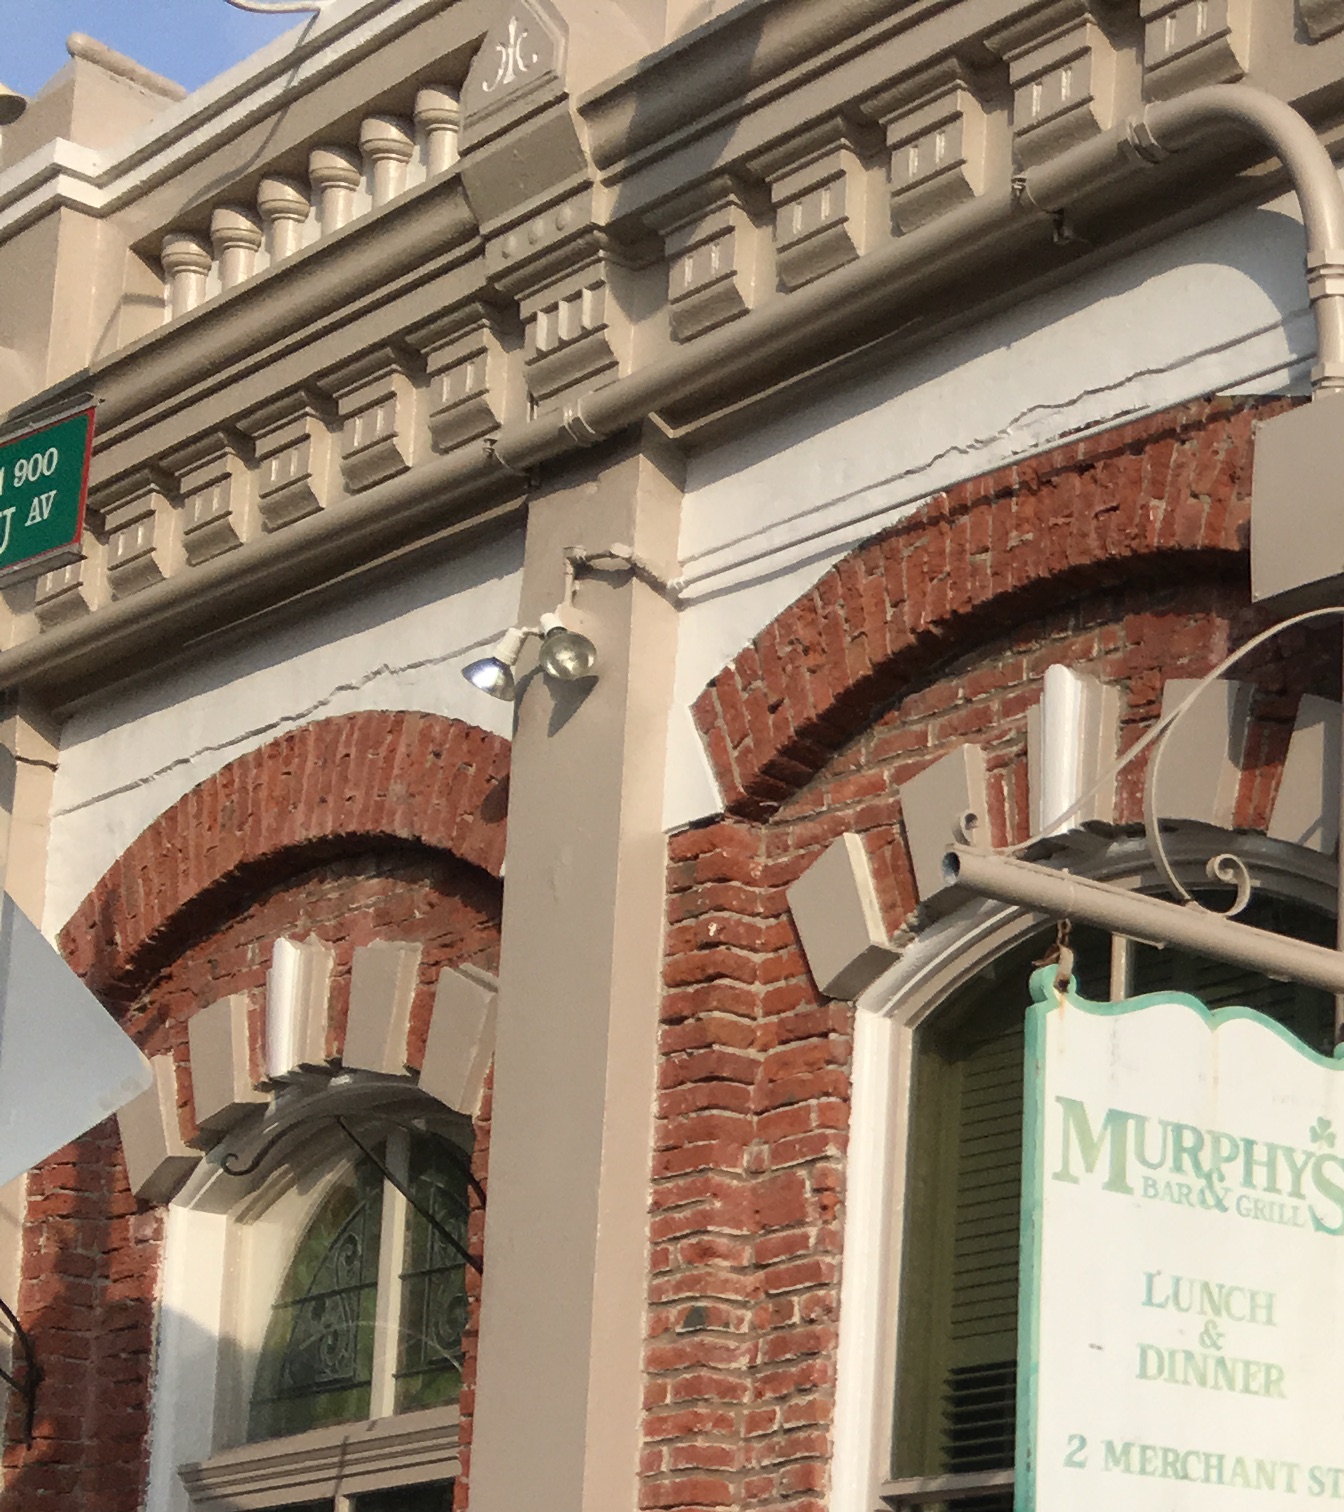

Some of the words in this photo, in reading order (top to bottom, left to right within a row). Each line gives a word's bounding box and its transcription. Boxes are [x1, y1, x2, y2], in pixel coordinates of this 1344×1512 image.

[13, 447, 58, 488] 900
[24, 490, 57, 527] AV
[1140, 1271, 1278, 1327] LUNCH
[1198, 1319, 1226, 1352] &
[1135, 1342, 1288, 1399] DINNER
[1063, 1433, 1089, 1469] 2
[1100, 1439, 1301, 1494] MERCHANT
